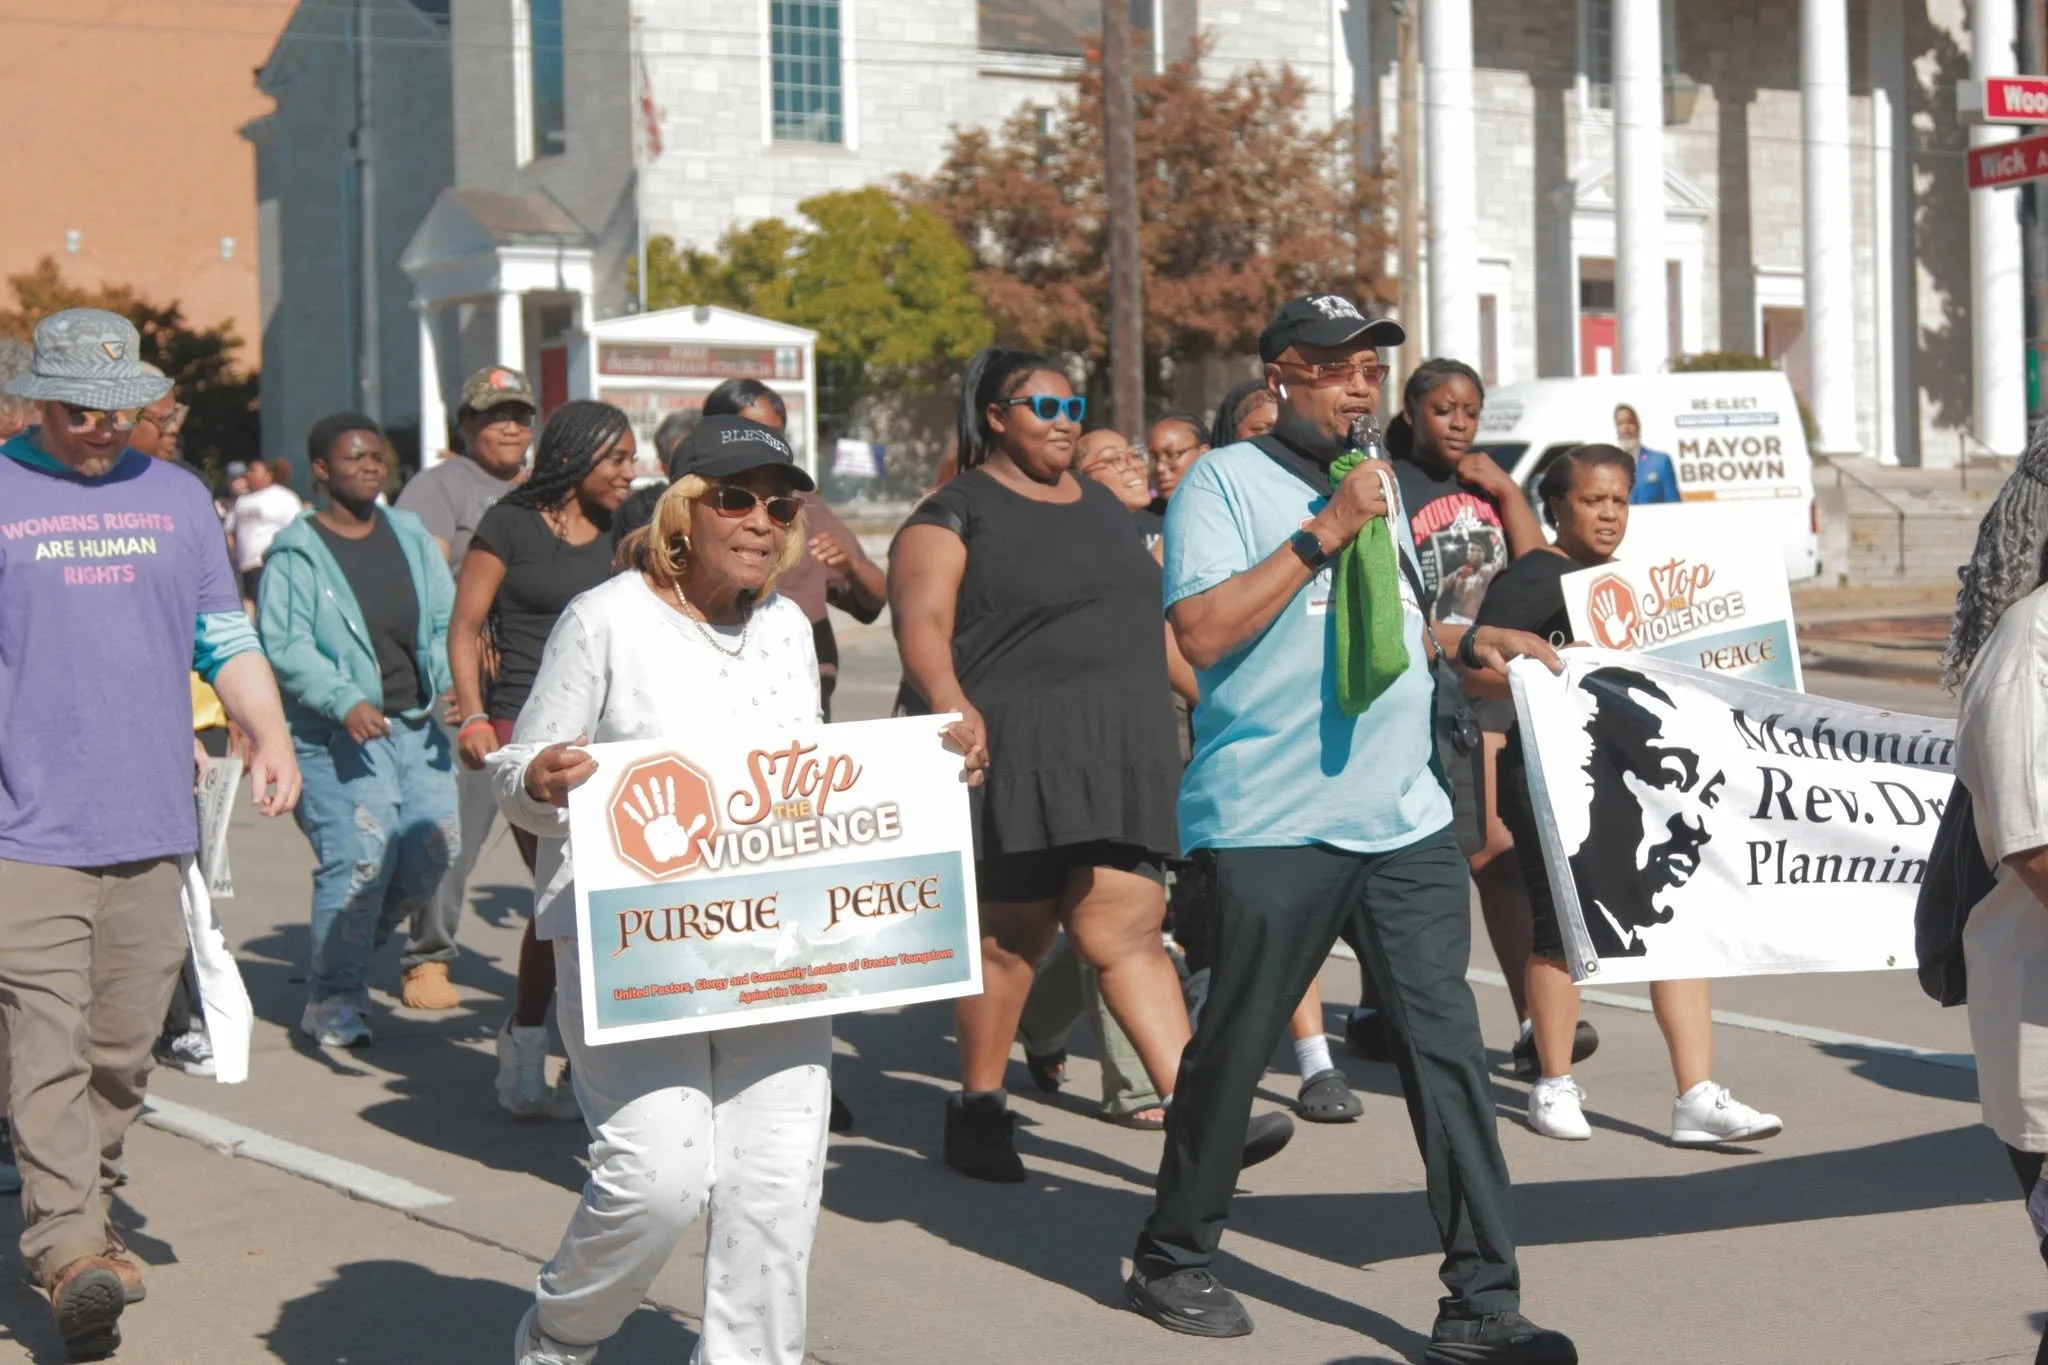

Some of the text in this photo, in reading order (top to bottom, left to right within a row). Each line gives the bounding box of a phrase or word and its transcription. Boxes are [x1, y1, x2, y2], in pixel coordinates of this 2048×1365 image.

[1980, 148, 2028, 180] Wick
[1690, 397, 1757, 410] RE-ELECT
[720, 429, 789, 457] BLESSED
[1678, 436, 1782, 458] MAYOR
[1680, 459, 1785, 483] BROWN
[0, 512, 175, 540] WOMENS RIGHTS
[36, 537, 157, 560] ARE HUMAN
[64, 564, 136, 585] RIGHTS
[1642, 557, 1716, 617] Stop
[1665, 595, 1686, 611] THE
[1629, 592, 1745, 648] VIOLENCE
[1700, 636, 1776, 670] PEACE
[1730, 708, 1954, 765] Mahonin
[728, 739, 863, 825] Stop
[1750, 765, 1874, 825] Rev.
[773, 800, 811, 820] THE
[697, 804, 902, 870] VIOLENCE
[1746, 839, 1929, 886] Plannin
[612, 872, 941, 958] PURSUE PEACE
[614, 949, 954, 1001] United Pastors, Clergy and Community Leaders of Greater Youngstown
[739, 982, 827, 1004] Against the Violence
